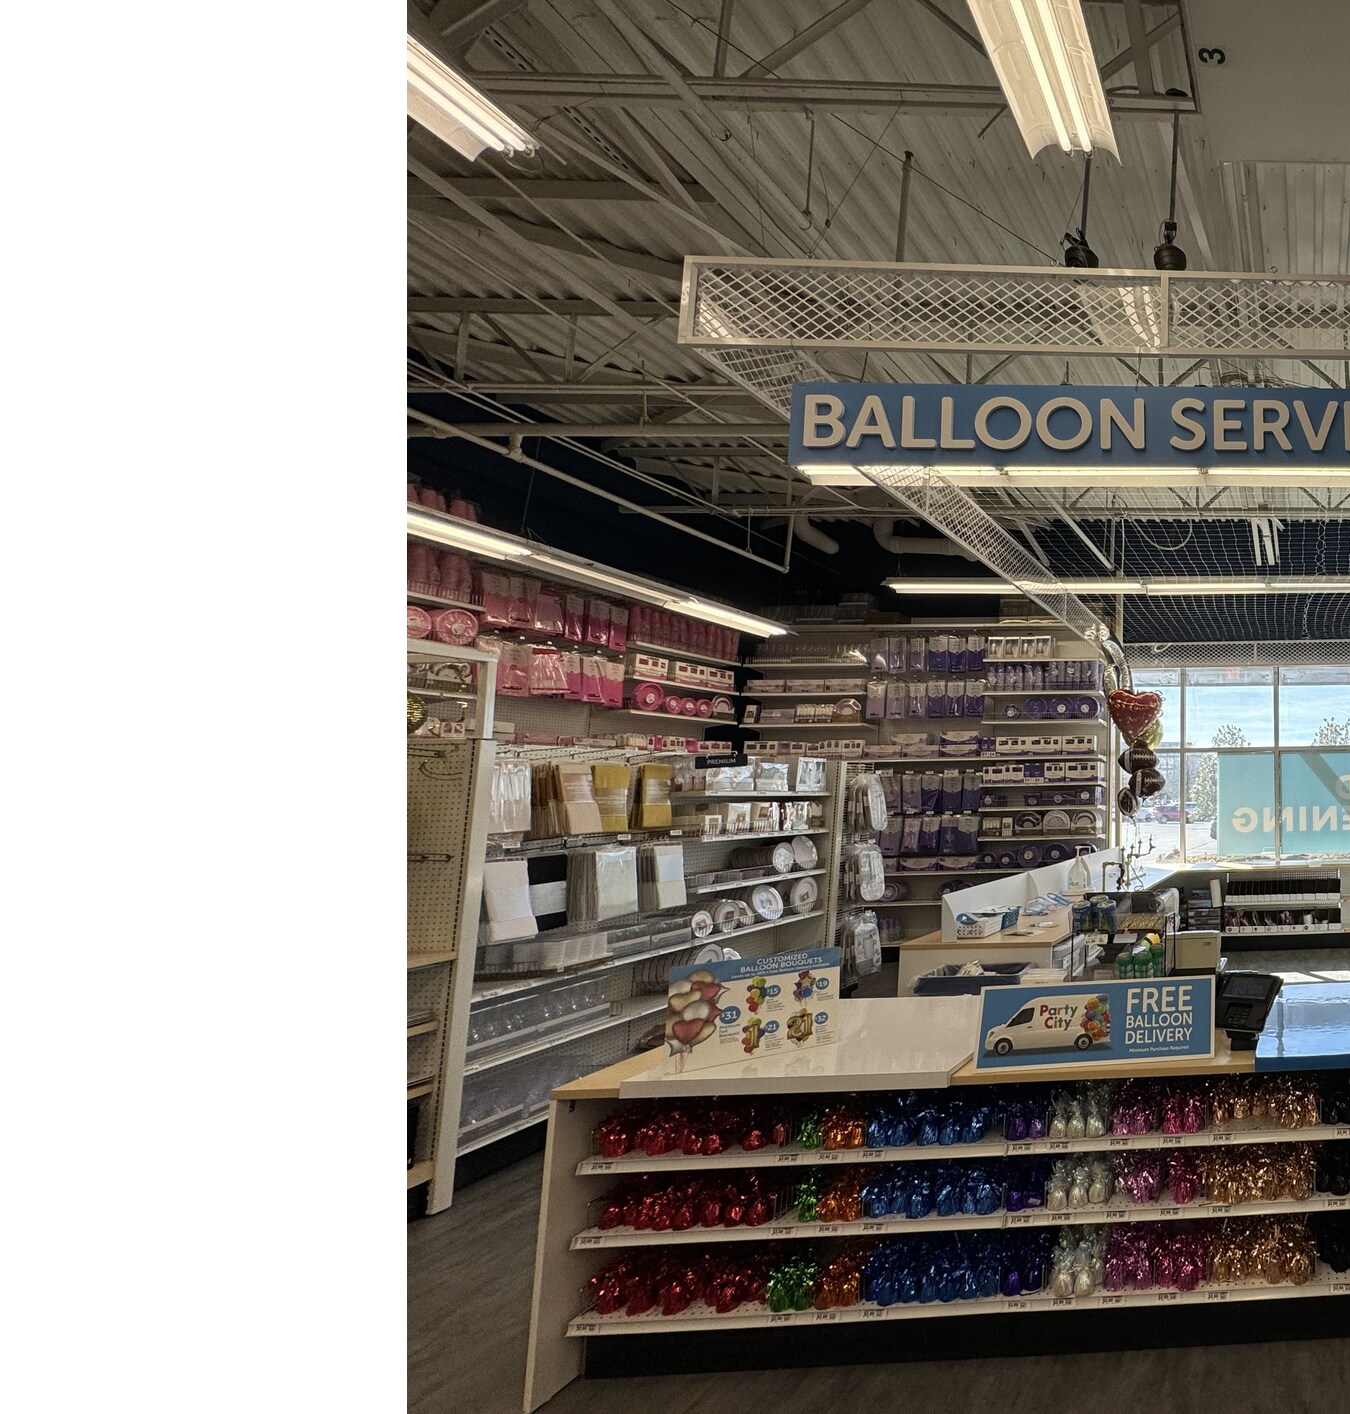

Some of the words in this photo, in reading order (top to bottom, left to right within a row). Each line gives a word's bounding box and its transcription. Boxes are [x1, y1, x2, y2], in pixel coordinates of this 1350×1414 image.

[1198, 48, 1225, 64] 3
[802, 394, 1145, 452] BALLOON
[740, 963, 779, 973] BALLOON
[780, 957, 823, 967] BOUQUETS
[757, 953, 808, 965] CUSTOMIZED
[1126, 985, 1193, 1014] FREE
[721, 1010, 738, 1020] $31
[1039, 1004, 1078, 1017] Party
[1044, 1017, 1072, 1031] City
[1126, 1012, 1193, 1029] BALLOON
[1125, 1027, 1193, 1044] DELIVERY
